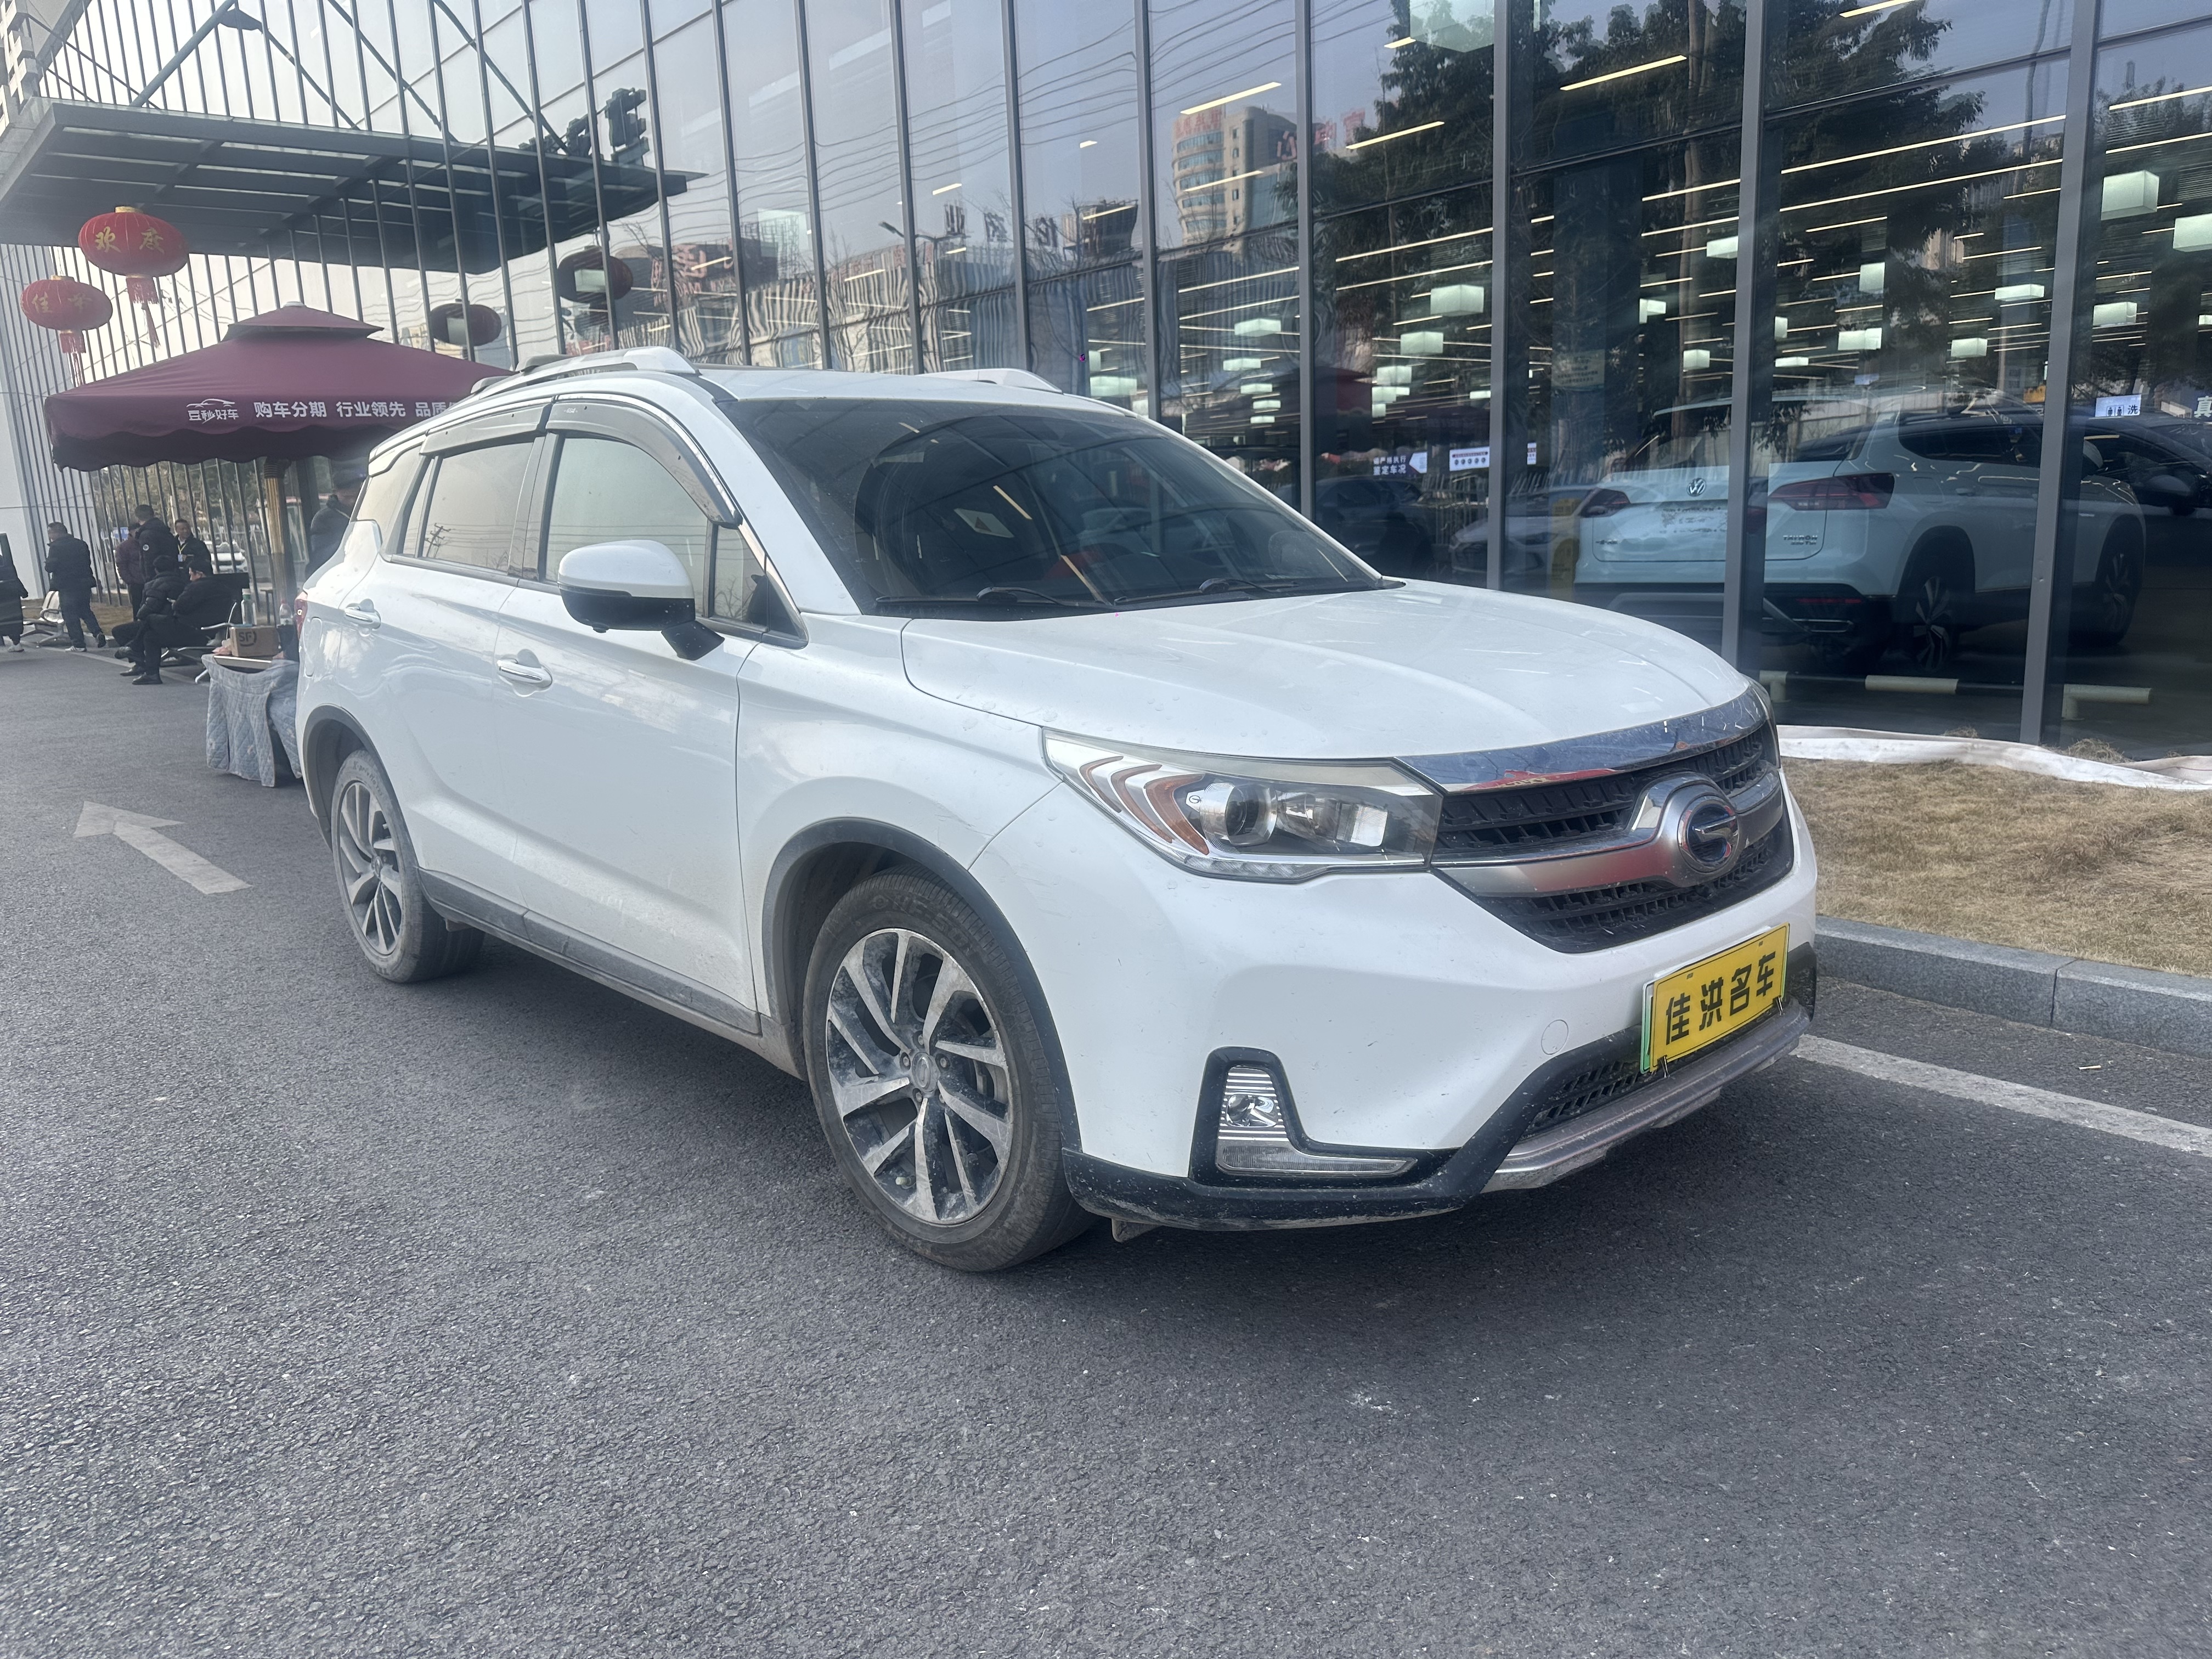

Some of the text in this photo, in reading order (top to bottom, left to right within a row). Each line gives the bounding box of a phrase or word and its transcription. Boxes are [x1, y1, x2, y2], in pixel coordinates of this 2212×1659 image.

[94, 225, 165, 255] 欢度
[253, 401, 458, 418] 购车分期 行业领先 品质
[2127, 404, 2140, 415] 洗
[1666, 951, 1776, 1046] 佳洪名车
